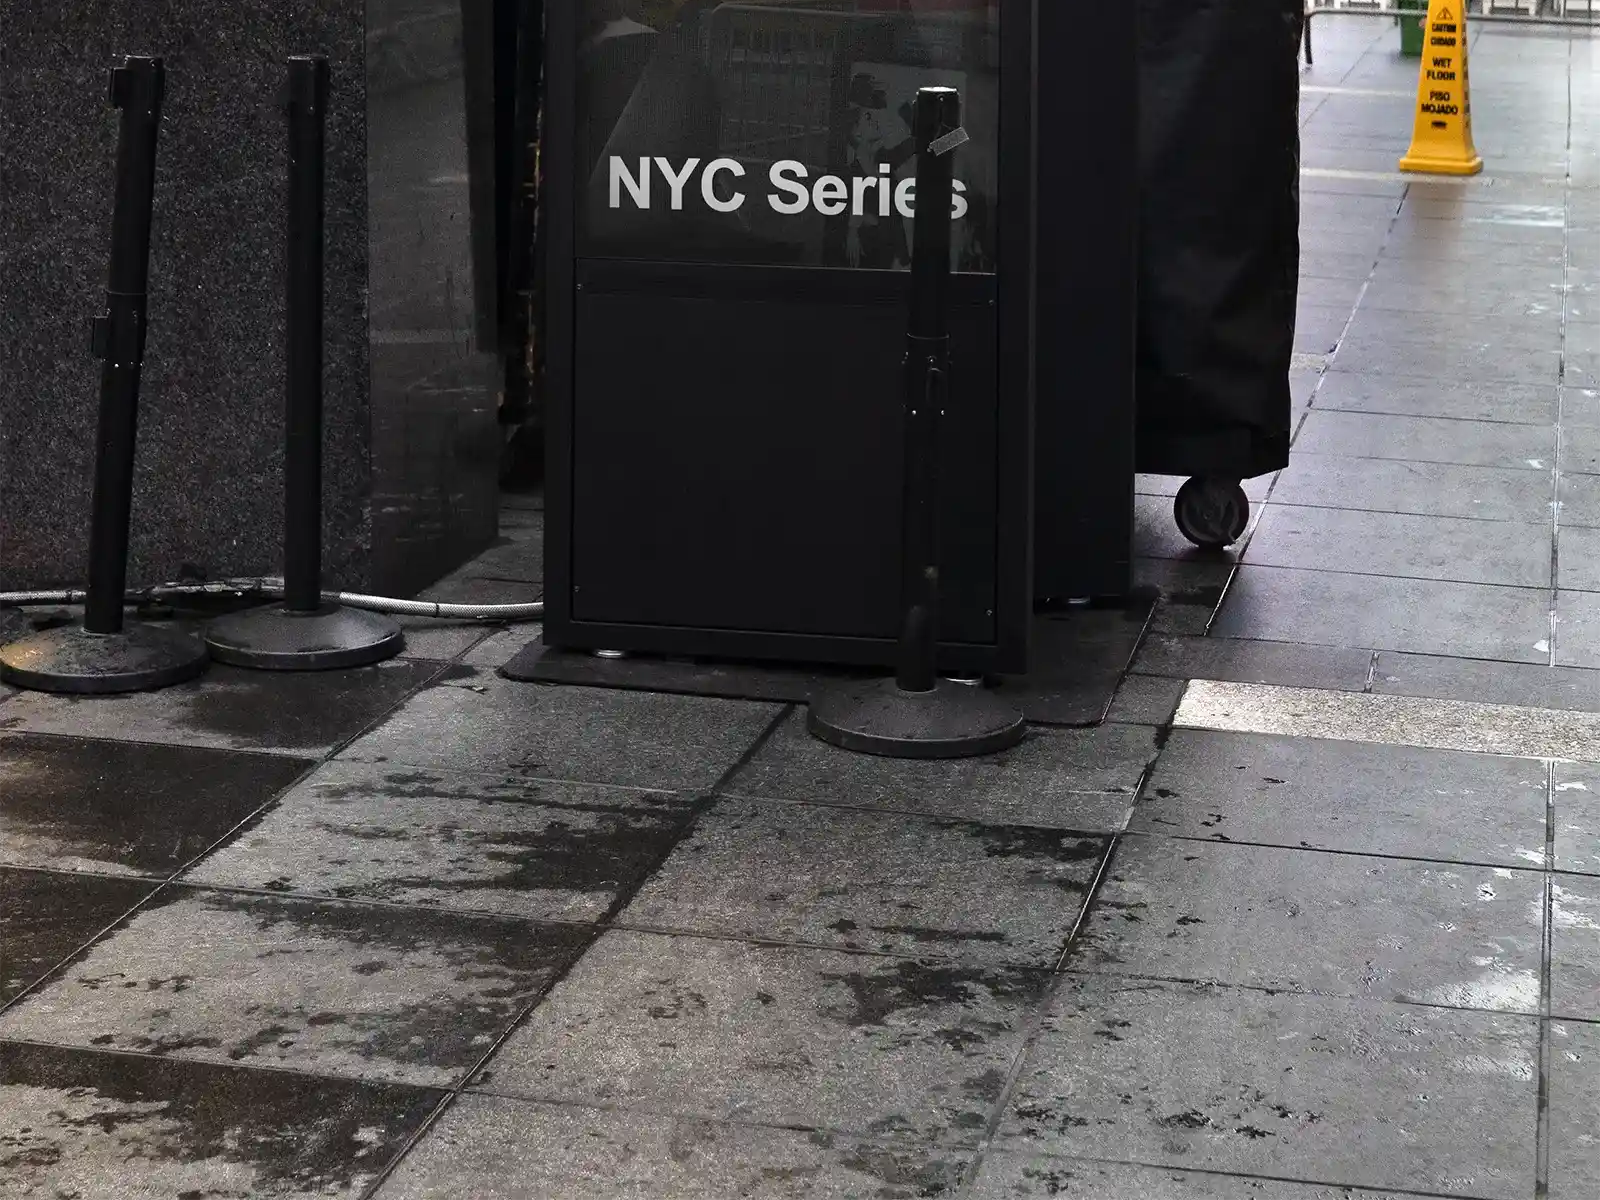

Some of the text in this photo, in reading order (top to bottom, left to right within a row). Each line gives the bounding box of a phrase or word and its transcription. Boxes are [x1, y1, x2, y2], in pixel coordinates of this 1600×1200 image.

[1432, 58, 1453, 69] WET
[1426, 70, 1456, 82] FLOOR
[1429, 90, 1451, 102] PISO
[1420, 102, 1460, 116] MOJADO
[609, 155, 747, 213] NYC
